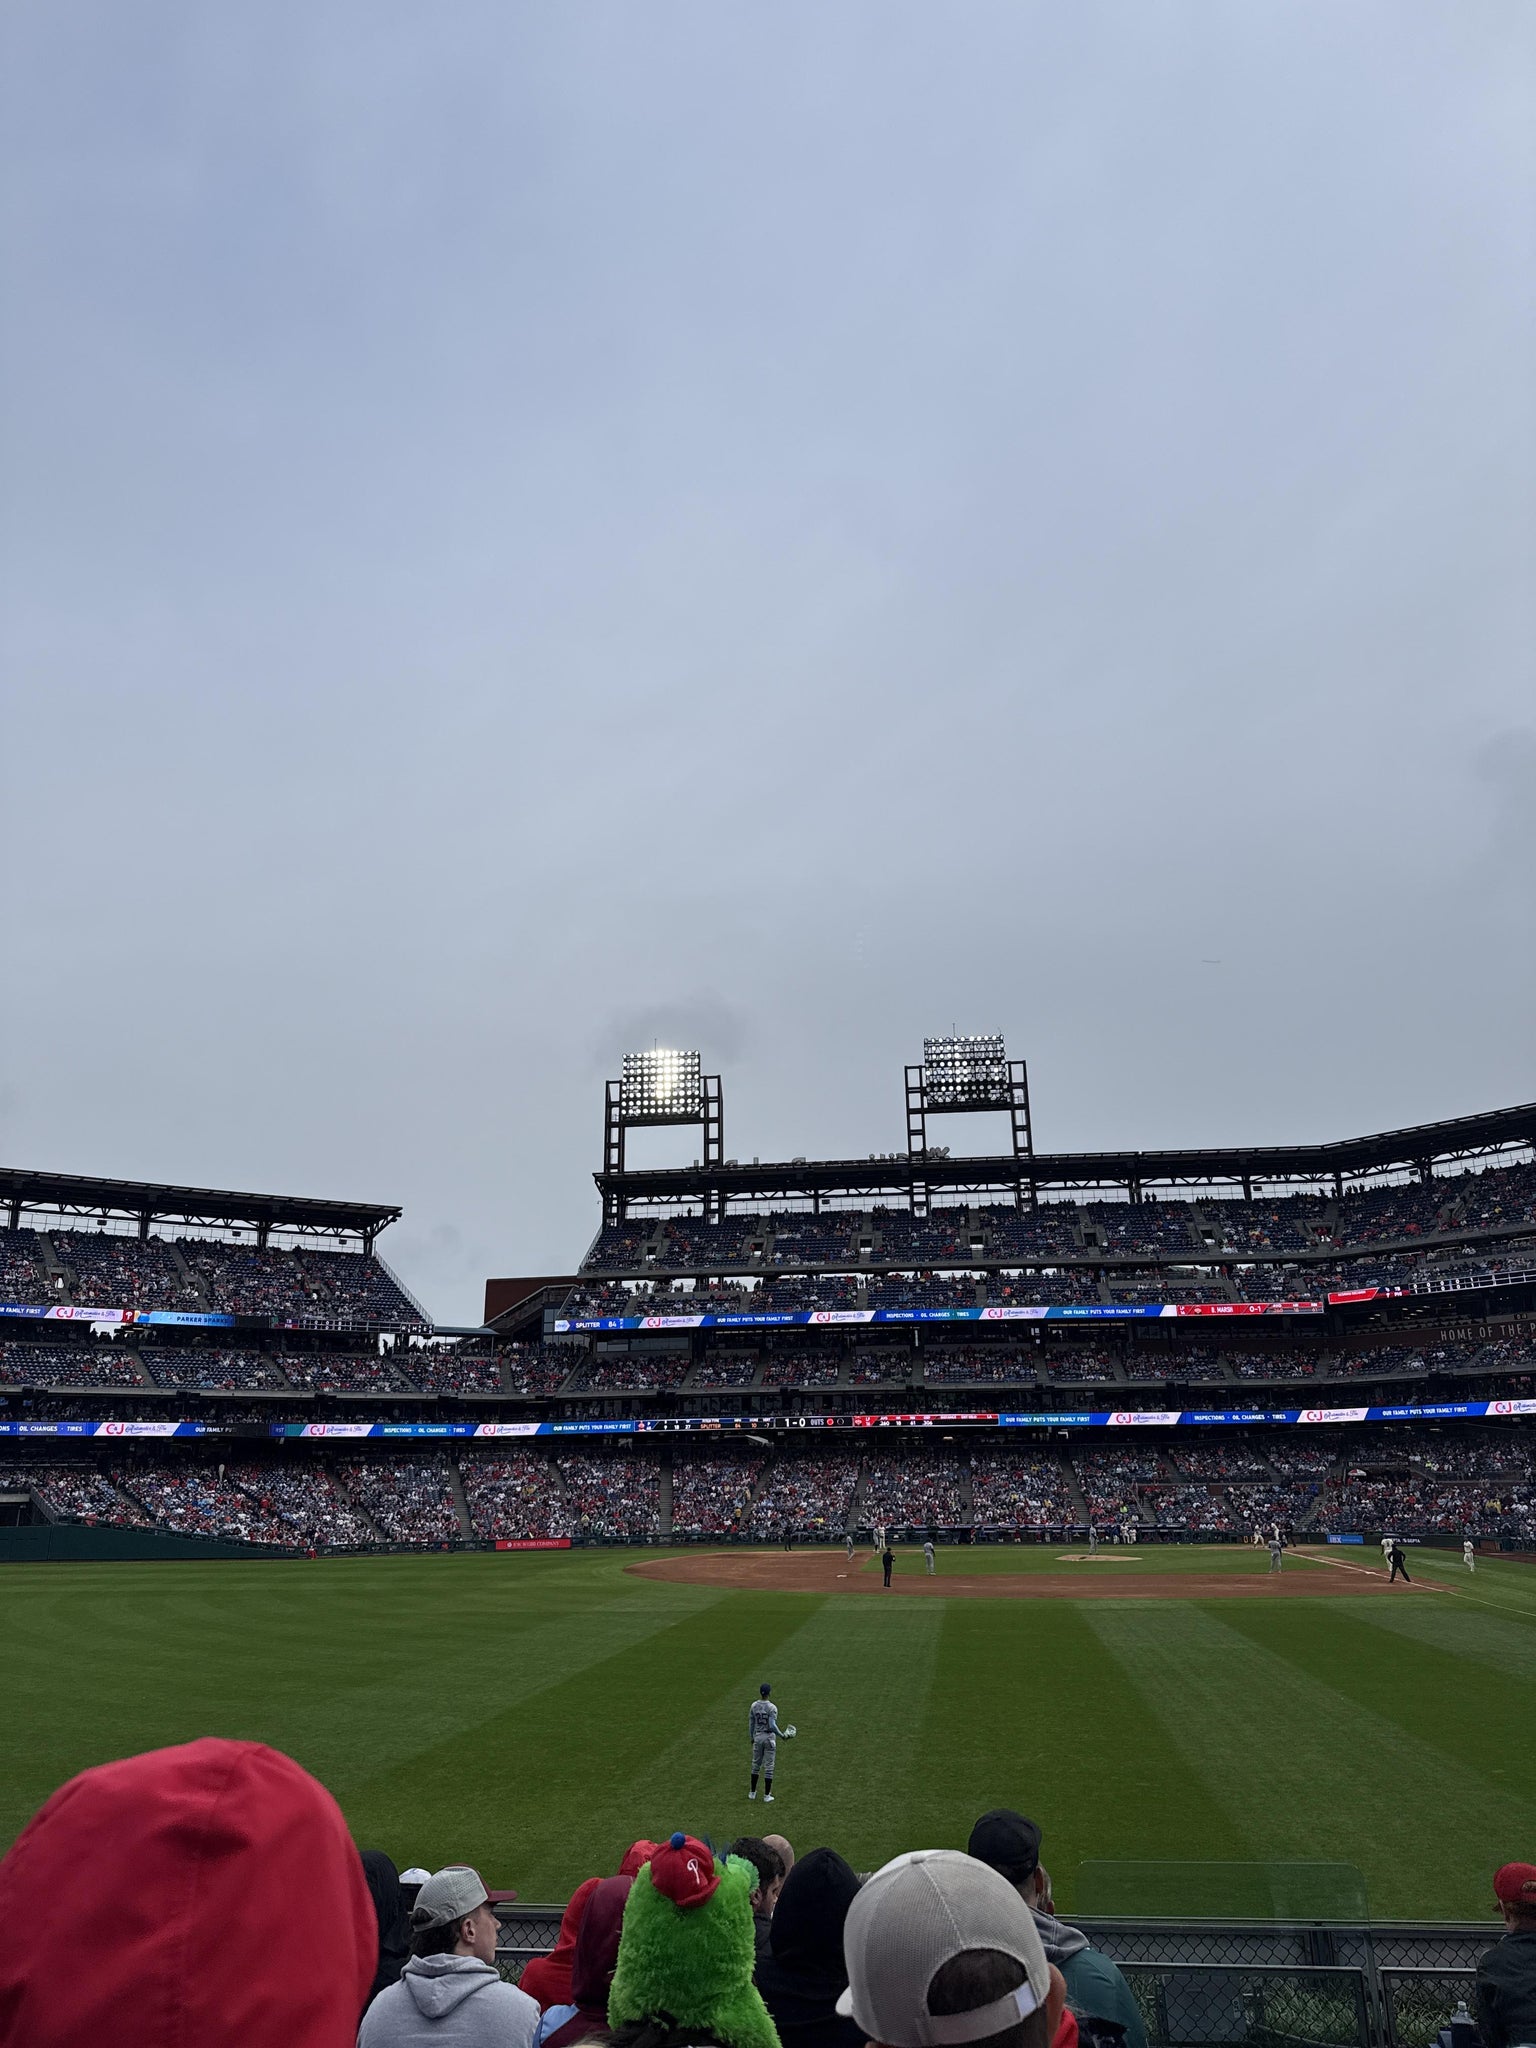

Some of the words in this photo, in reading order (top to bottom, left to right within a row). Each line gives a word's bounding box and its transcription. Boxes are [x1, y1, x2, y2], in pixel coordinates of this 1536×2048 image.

[56, 1307, 74, 1318] C&J
[816, 1313, 830, 1322] C&J
[988, 1309, 1002, 1318] C&J
[647, 1318, 661, 1328] C&J
[1440, 1328, 1472, 1340] HOME
[1479, 1326, 1493, 1338] OF
[1500, 1324, 1522, 1336] THE
[1495, 1402, 1512, 1413] C&J
[1116, 1414, 1131, 1424] C&J
[1306, 1411, 1323, 1421] C&J
[106, 1424, 124, 1434] C&J
[310, 1425, 326, 1435] C&J
[483, 1425, 496, 1434] C&J
[1330, 1535, 1342, 1543] IBX
[687, 1858, 700, 1885] P
